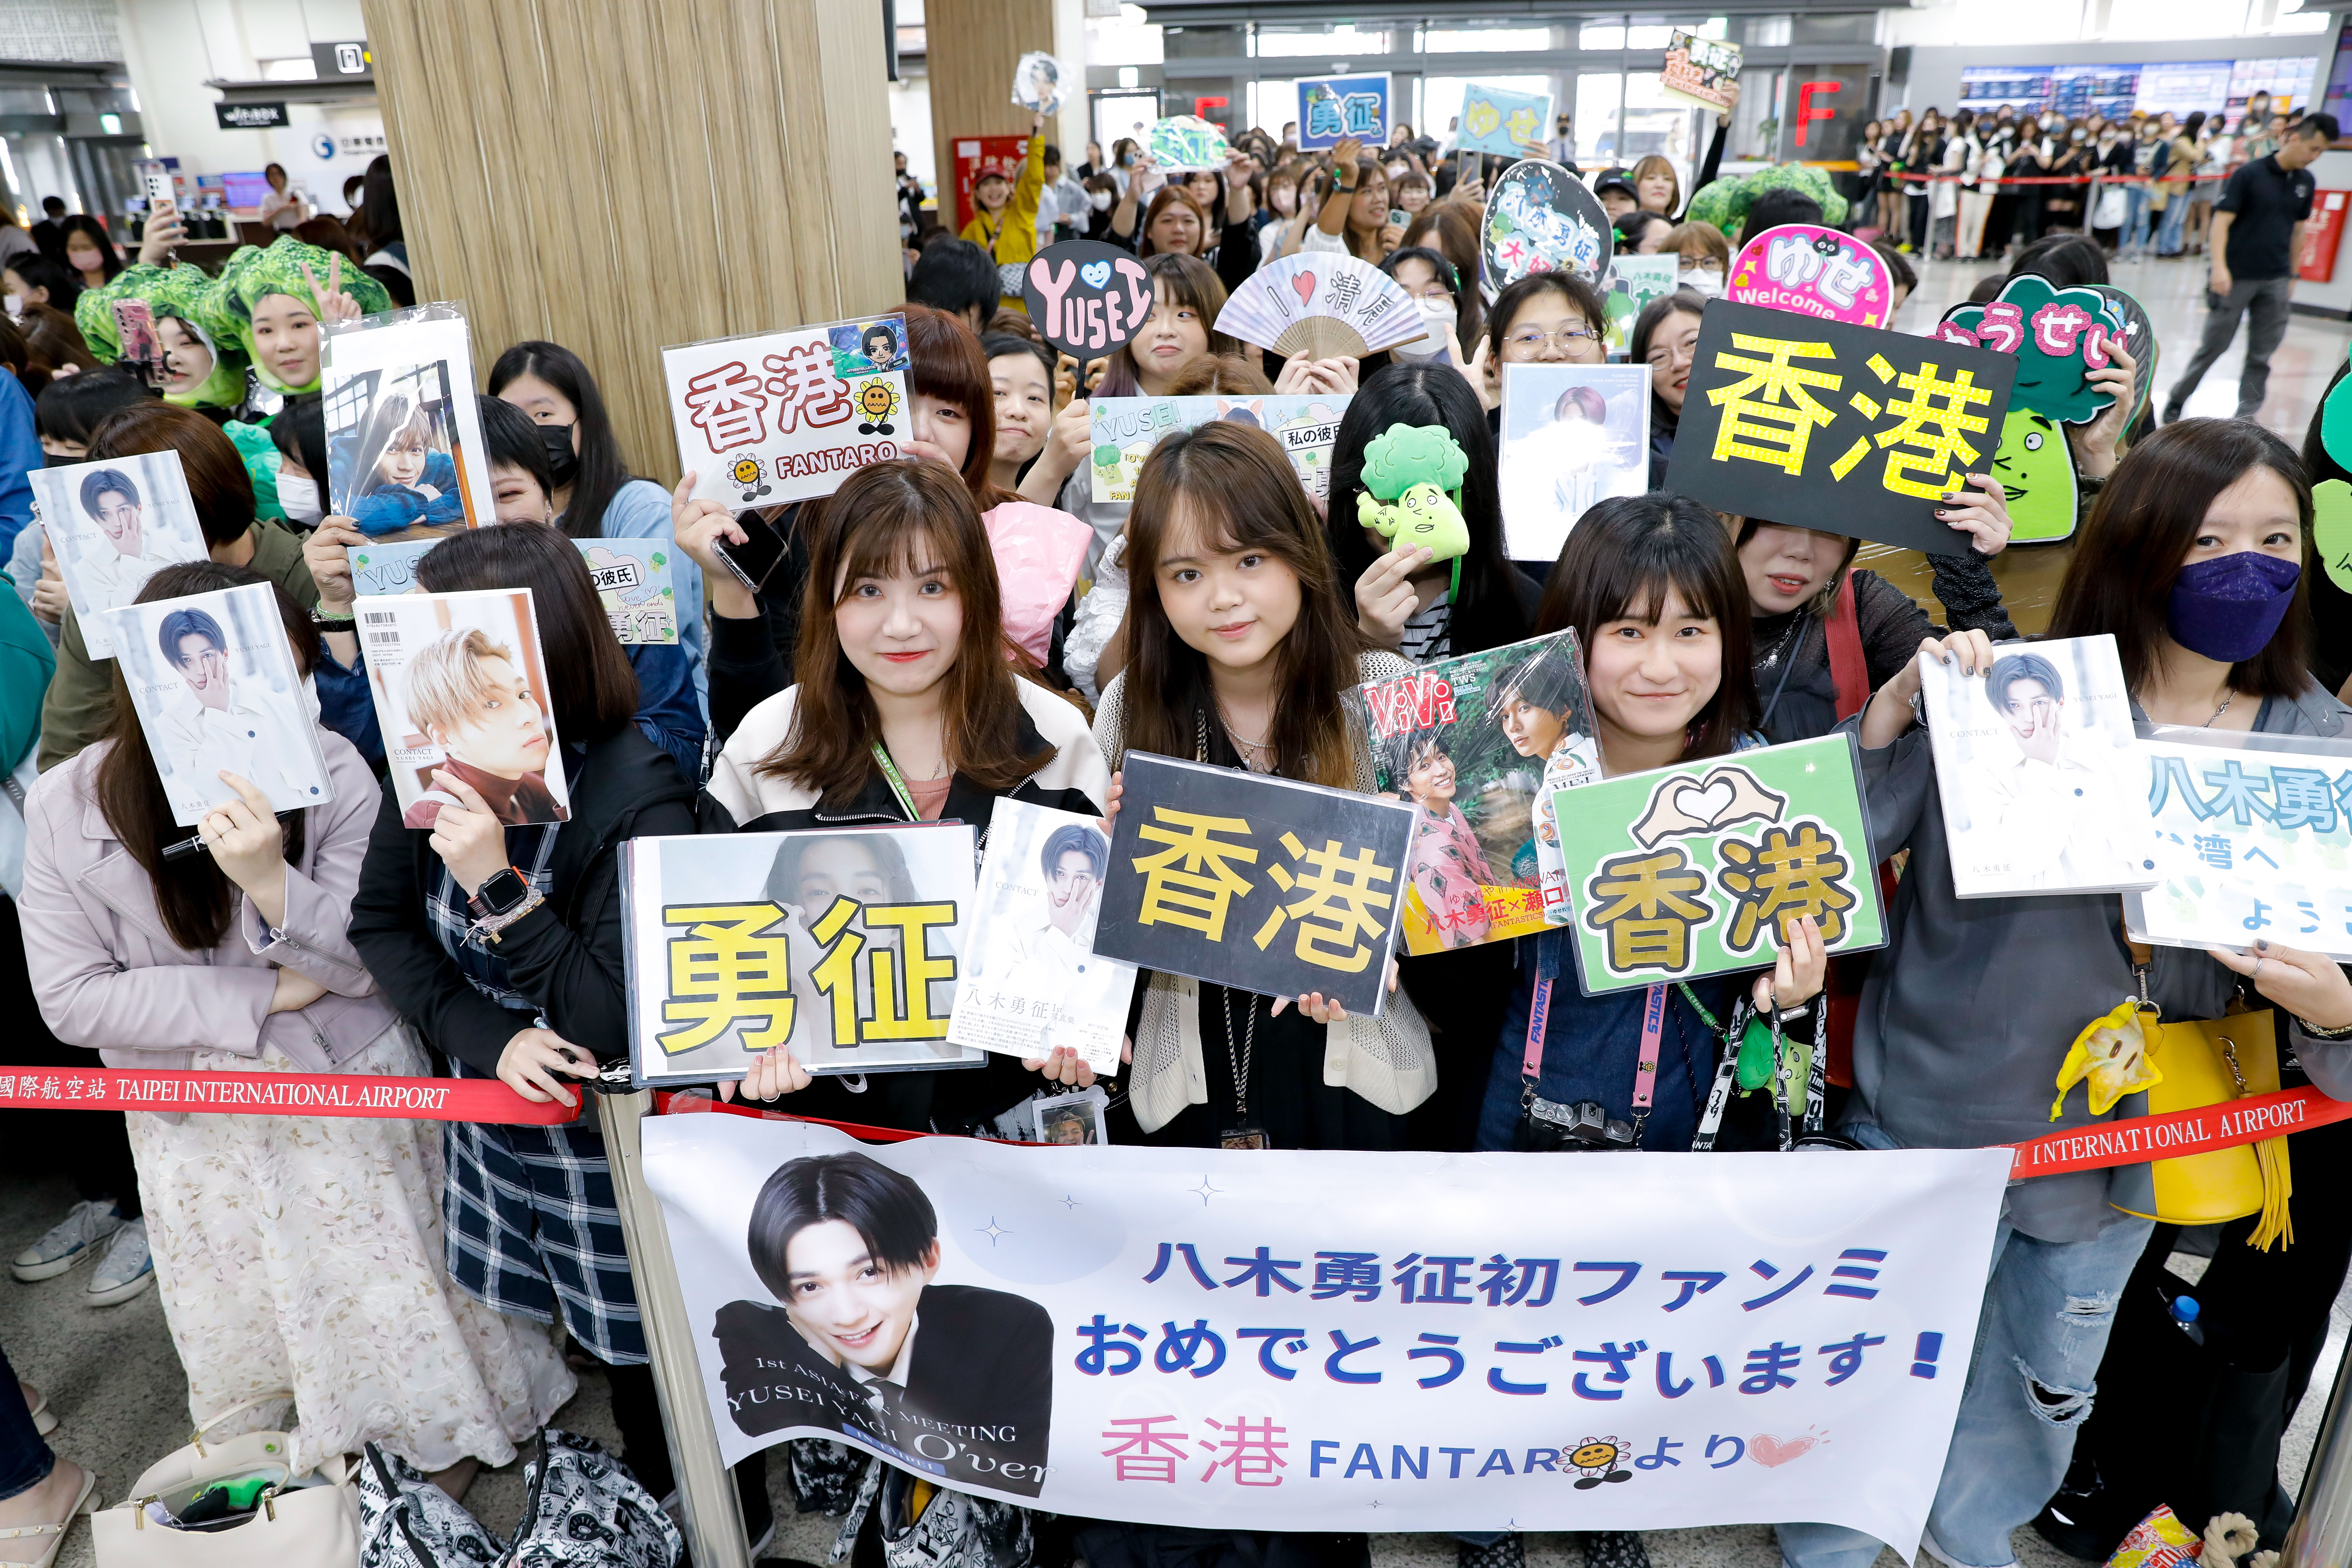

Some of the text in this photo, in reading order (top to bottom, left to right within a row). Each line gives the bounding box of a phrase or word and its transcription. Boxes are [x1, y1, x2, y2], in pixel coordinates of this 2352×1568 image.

[1311, 97, 1377, 135] 勇征
[1467, 101, 1538, 144] ゆせ
[1795, 81, 1842, 146] F
[1767, 234, 1875, 310] ゆせ
[1736, 288, 1835, 319] Welcome
[685, 341, 853, 454] 香港
[1706, 332, 1993, 501] 香港
[1100, 400, 1181, 442] YUSEI
[776, 440, 897, 480] FANTARO
[1110, 491, 1130, 500] FAN
[60, 532, 97, 543] CONTACT
[364, 555, 420, 591] YUS
[139, 682, 178, 694] CONTACT
[1451, 673, 1476, 686] TWS
[1362, 670, 1457, 739] ViVi
[1950, 728, 1999, 738] CONTACT
[182, 800, 210, 810] 八木勇征
[983, 820, 994, 862] CONTACT
[996, 881, 1038, 897] CONTACT
[1131, 806, 1394, 972] 香港
[1972, 863, 2011, 874] 八木勇征
[1450, 886, 1494, 905] ゆせれや
[1499, 885, 1507, 893] in
[1591, 823, 1854, 970] 香港
[655, 894, 957, 1057] 勇征
[963, 989, 1063, 1019] 八木勇征 1st
[1050, 1012, 1075, 1024] 写真集
[0, 1075, 451, 1110] 國際航空站 TAIPEI INTERNATIONAL AIRPORT
[2032, 1119, 2211, 1165] INTERNATIONAL
[2221, 1099, 2306, 1136] AIRPORT
[1141, 1241, 1890, 1314] 八木勇征初ファンミ
[1073, 1314, 1946, 1400] おめでとうございます！
[727, 1385, 898, 1442] YUSEI YAGI
[757, 1357, 1016, 1442] 1st ASIA FAN MEETING
[856, 1430, 934, 1470] IN TAIPEI
[913, 1433, 1057, 1483] O'ver
[1101, 1415, 1290, 1487] 香港
[1634, 1433, 1749, 1471] より
